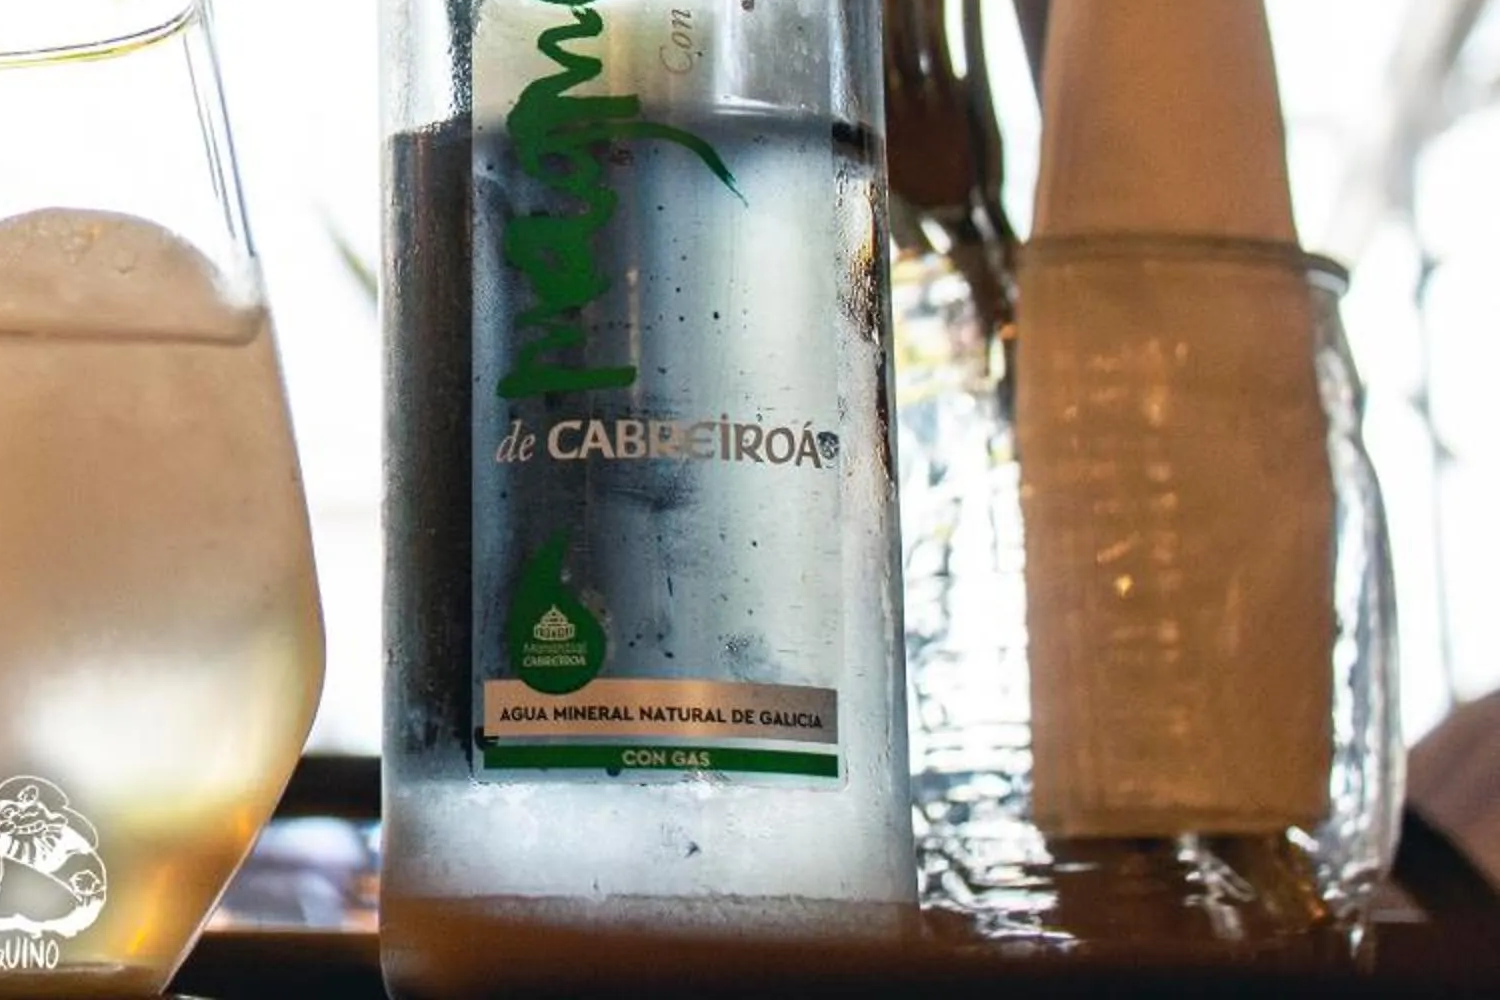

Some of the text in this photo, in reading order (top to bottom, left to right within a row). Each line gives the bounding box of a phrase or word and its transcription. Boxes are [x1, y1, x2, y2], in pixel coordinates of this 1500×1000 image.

[659, 8, 694, 75] Con
[495, 419, 536, 464] de
[500, 706, 824, 729] AGUA MINERAL NATURAL DE GALICIA
[621, 749, 711, 767] CON GAS
